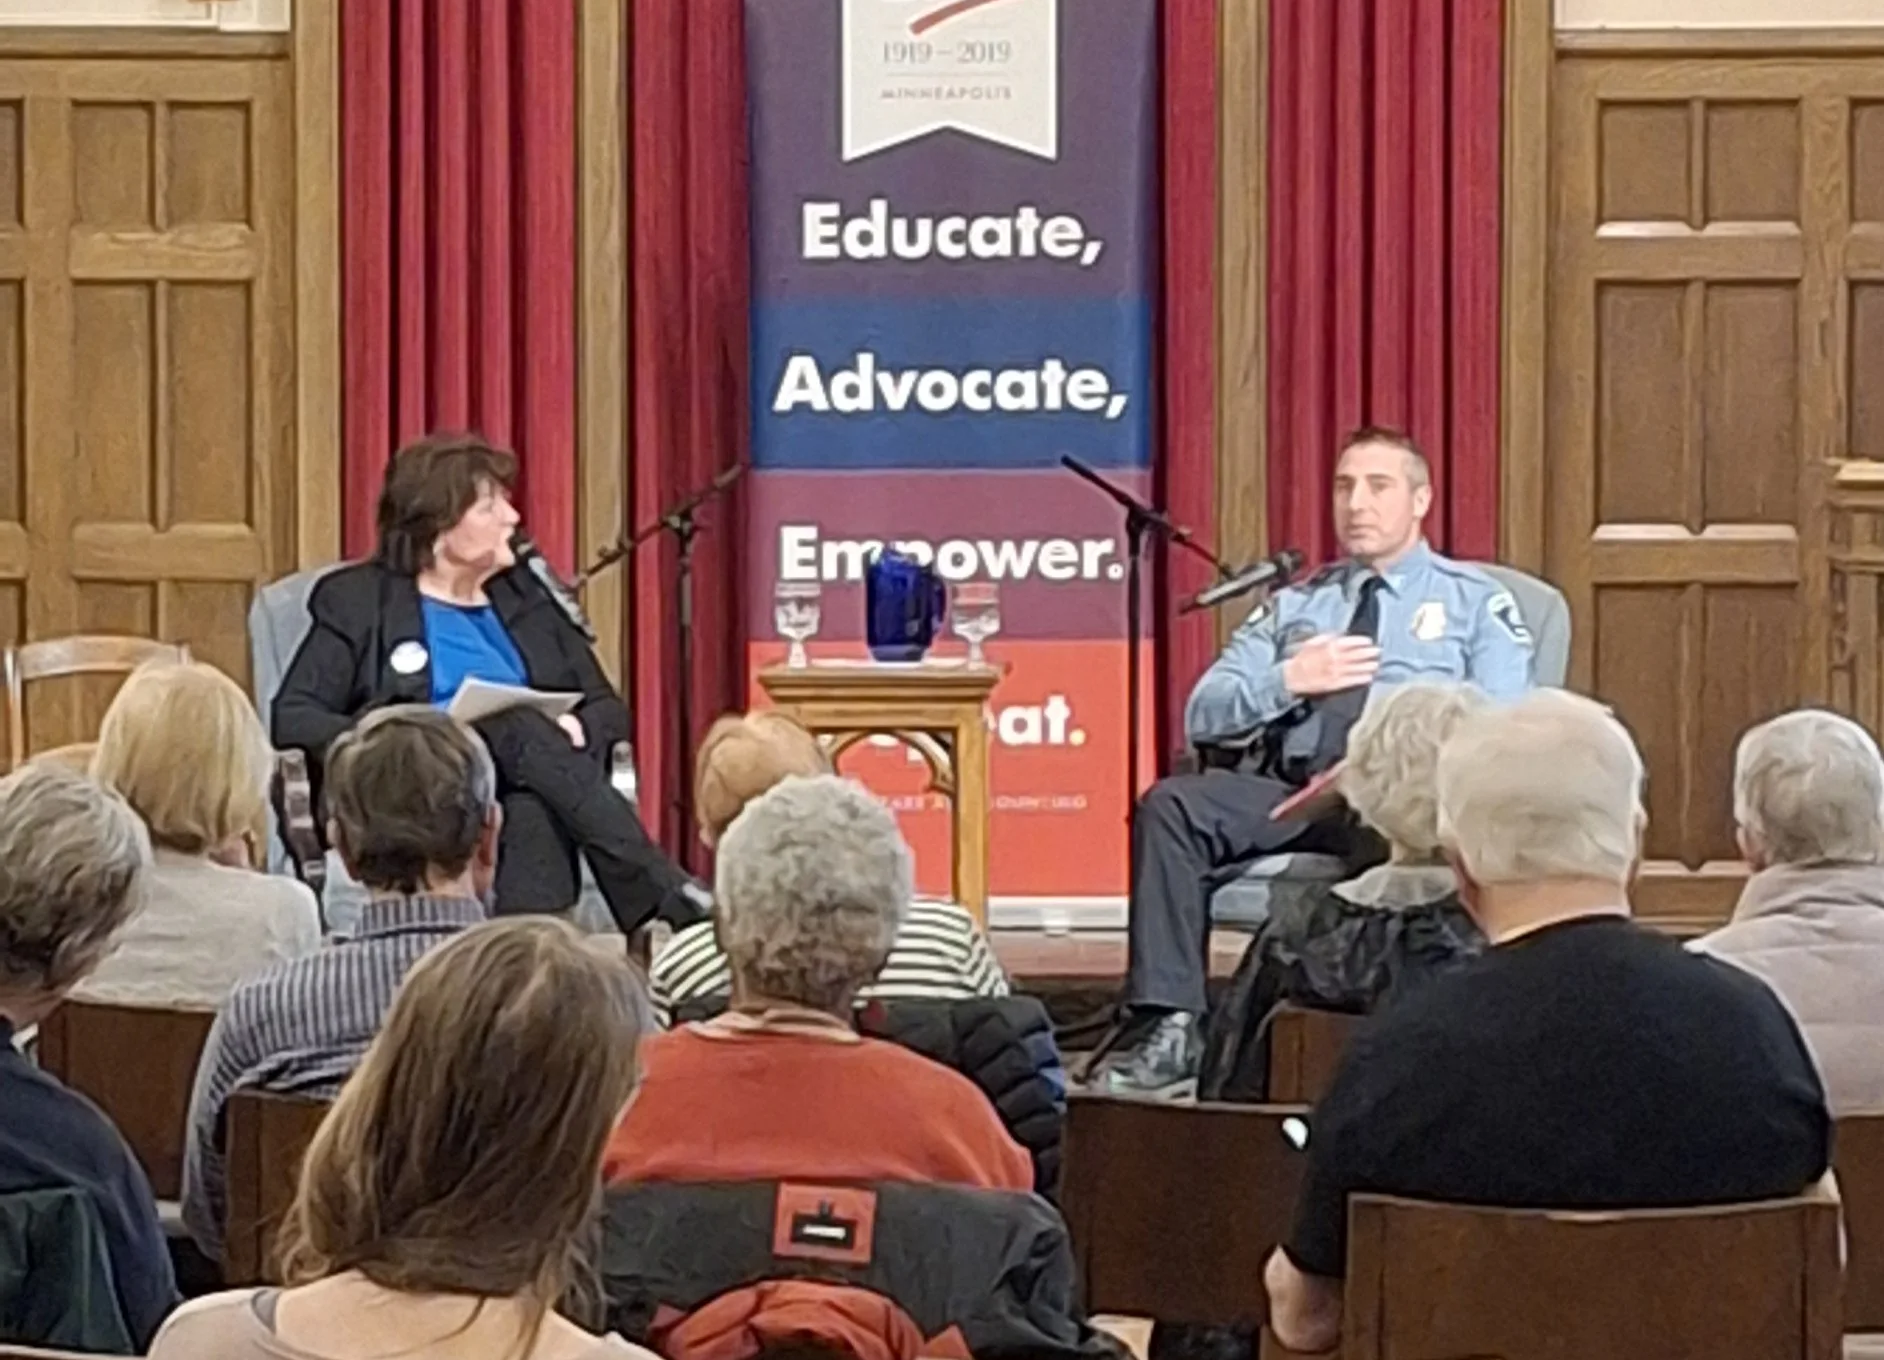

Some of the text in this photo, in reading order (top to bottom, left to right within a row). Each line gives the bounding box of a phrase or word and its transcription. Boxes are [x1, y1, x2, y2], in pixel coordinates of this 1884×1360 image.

[880, 86, 1012, 99] MINNEAPOLIS
[801, 199, 1102, 265] Educate,
[773, 353, 1129, 419] Advocate,
